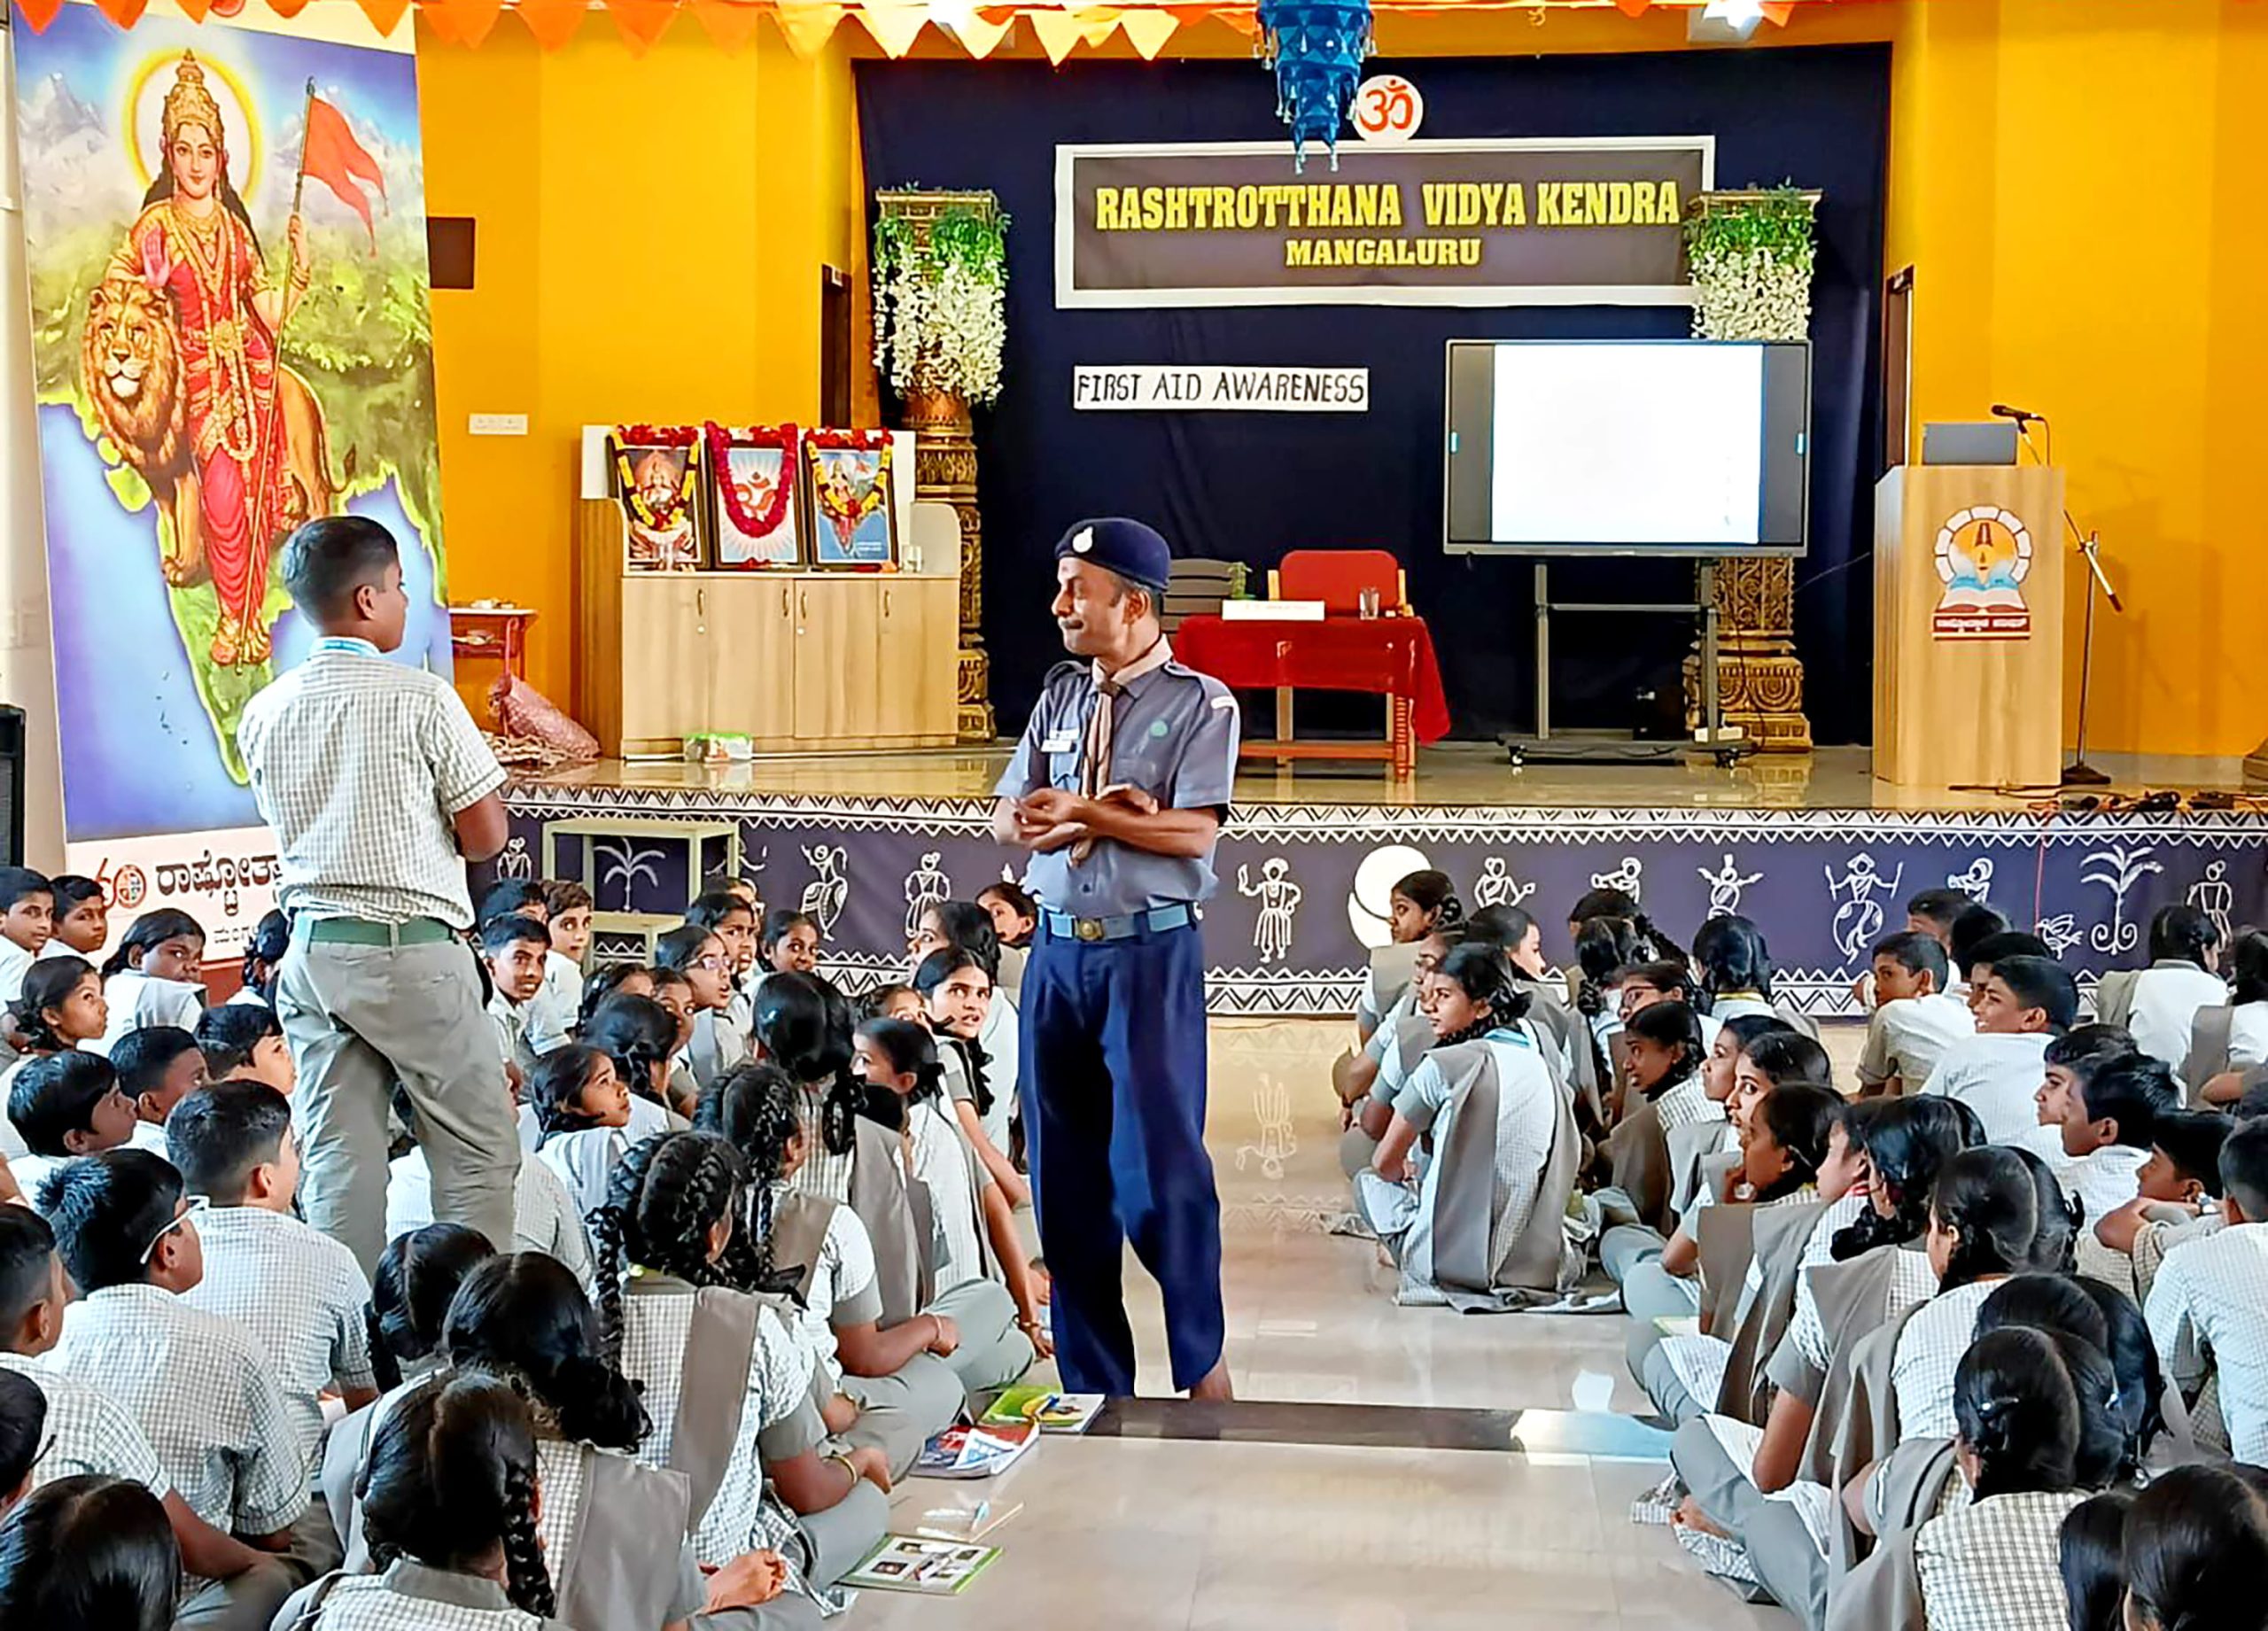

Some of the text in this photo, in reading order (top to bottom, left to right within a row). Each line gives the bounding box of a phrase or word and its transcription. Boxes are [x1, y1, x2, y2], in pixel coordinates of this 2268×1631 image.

[1096, 181, 1680, 230] RASHTROTTHANA VIDYA KENDRA
[1285, 238, 1481, 267] MANGALURU
[1077, 372, 1364, 403] FIRST AID AWARENESS
